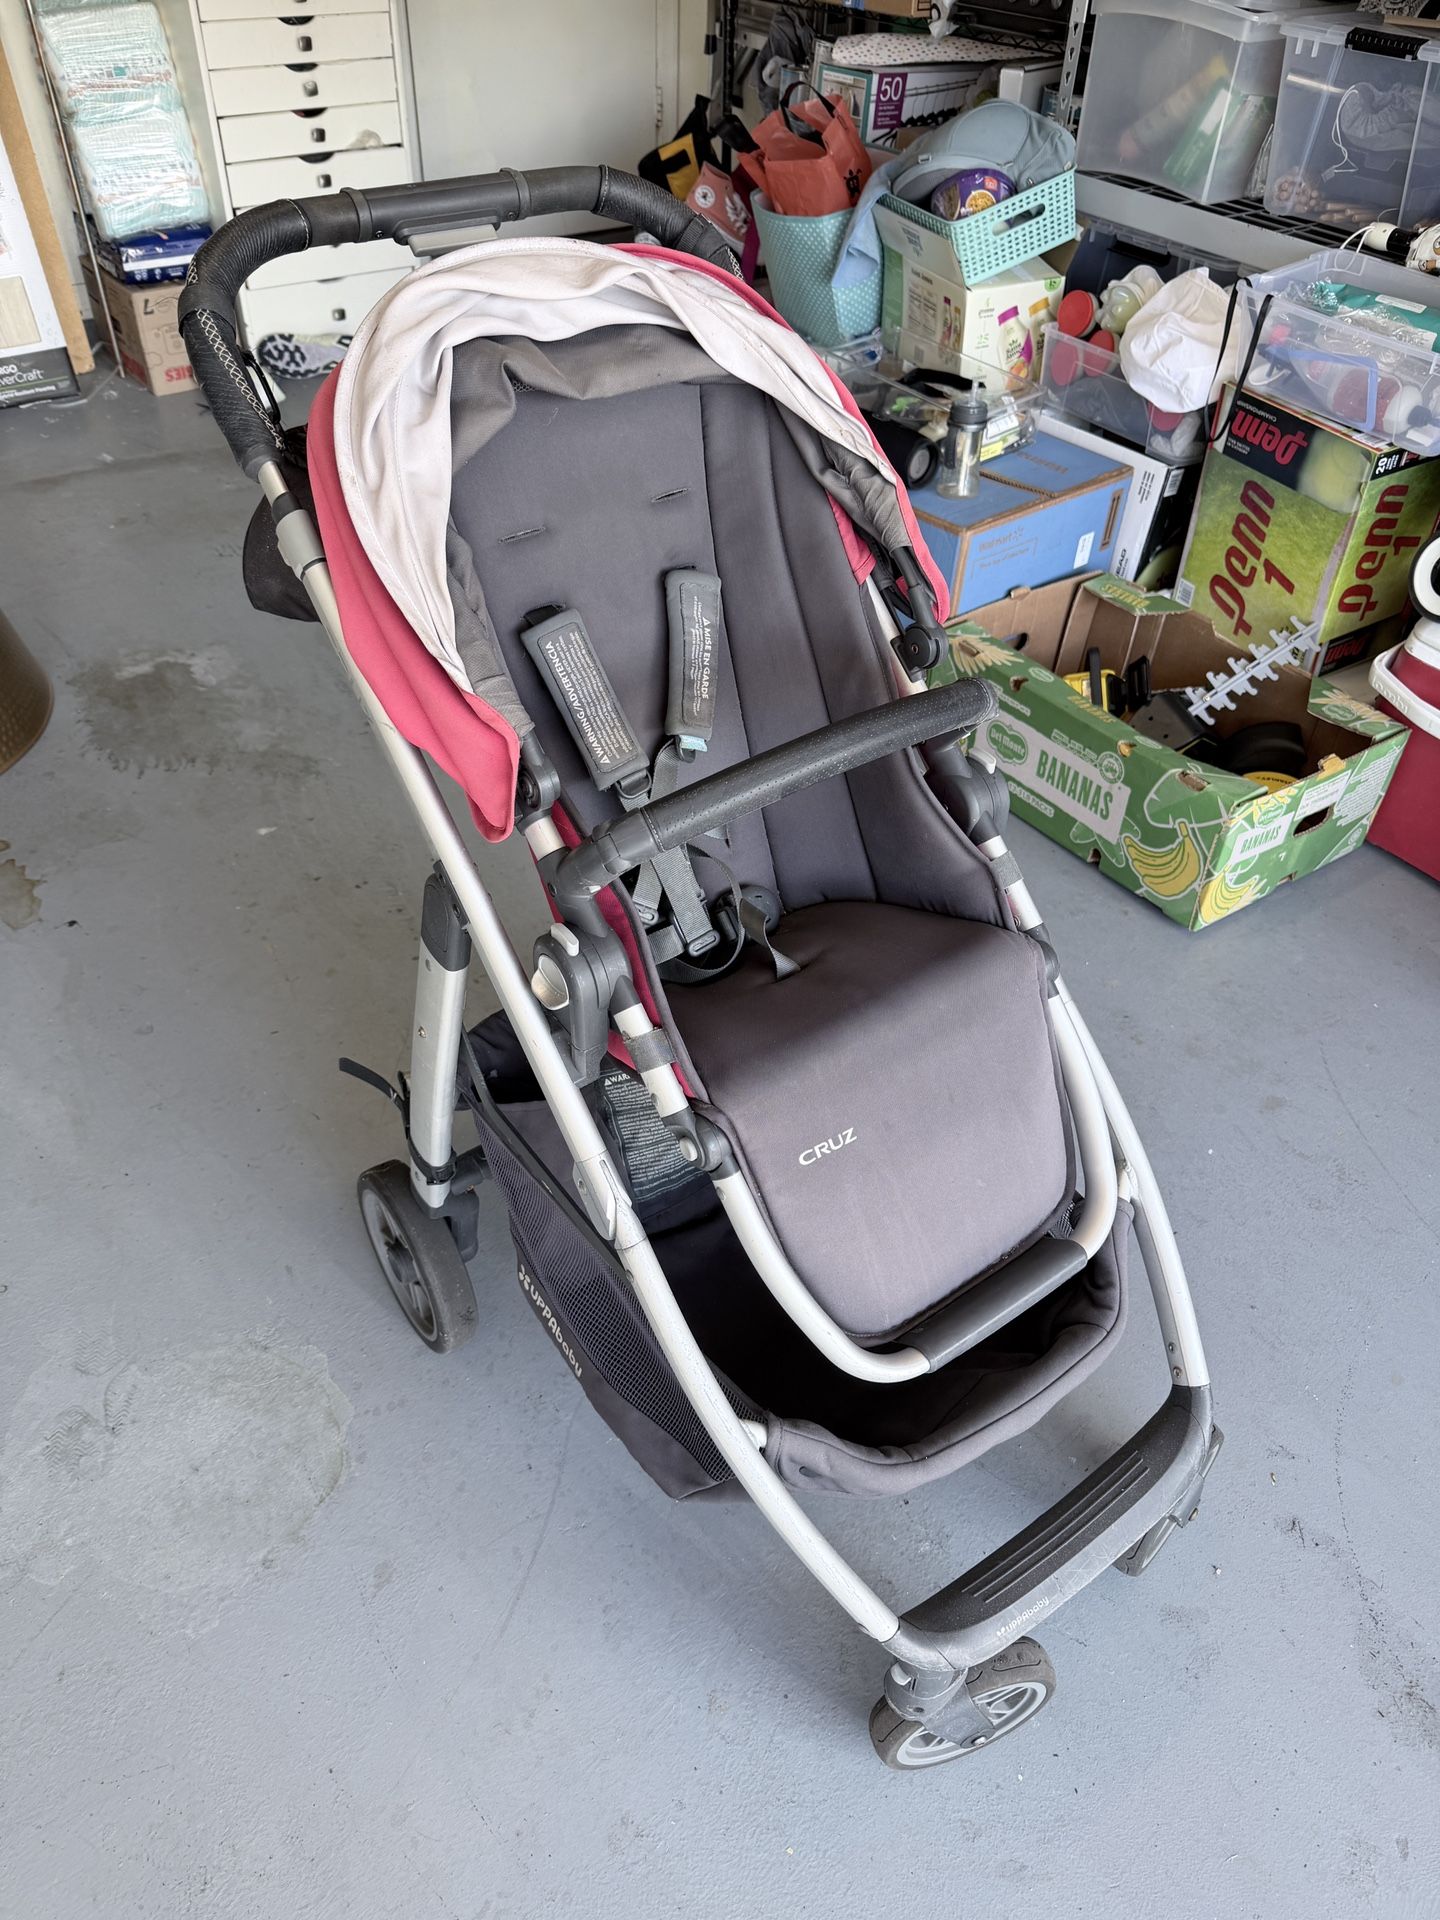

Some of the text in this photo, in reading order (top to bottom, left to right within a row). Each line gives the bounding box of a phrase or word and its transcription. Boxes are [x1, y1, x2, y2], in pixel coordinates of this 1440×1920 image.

[880, 76, 902, 101] 50
[1237, 401, 1277, 422] CHAMPIONSHIP
[1393, 536, 1422, 557] 1
[1263, 558, 1295, 595] 1
[702, 652, 711, 666] EN
[702, 667, 710, 700] GARDE
[545, 641, 606, 758] WARNING/ADVERTENCIA
[990, 727, 1025, 756] Del Monte
[1036, 749, 1113, 820] BANANAS
[1031, 798, 1055, 816] PACKS
[1241, 826, 1281, 853] BANANAS
[609, 1073, 630, 1085] WAR
[799, 1127, 858, 1165] CRUZ
